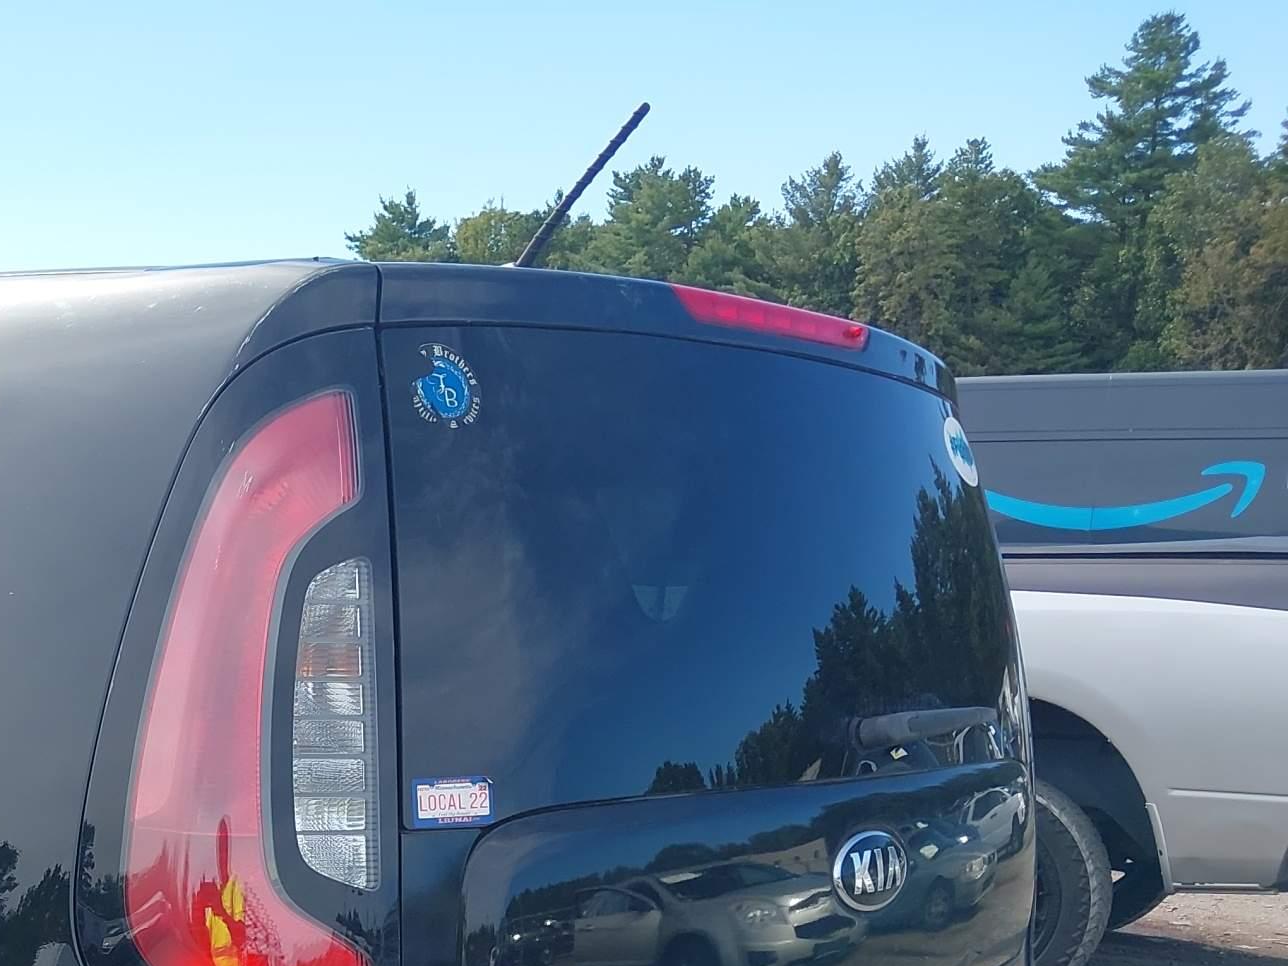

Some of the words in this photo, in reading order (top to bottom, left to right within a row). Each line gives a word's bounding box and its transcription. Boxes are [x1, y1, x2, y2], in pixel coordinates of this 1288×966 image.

[432, 345, 478, 386] Brothers
[418, 793, 466, 812] LOCAL
[469, 791, 489, 809] 22
[849, 846, 902, 895] KIA
